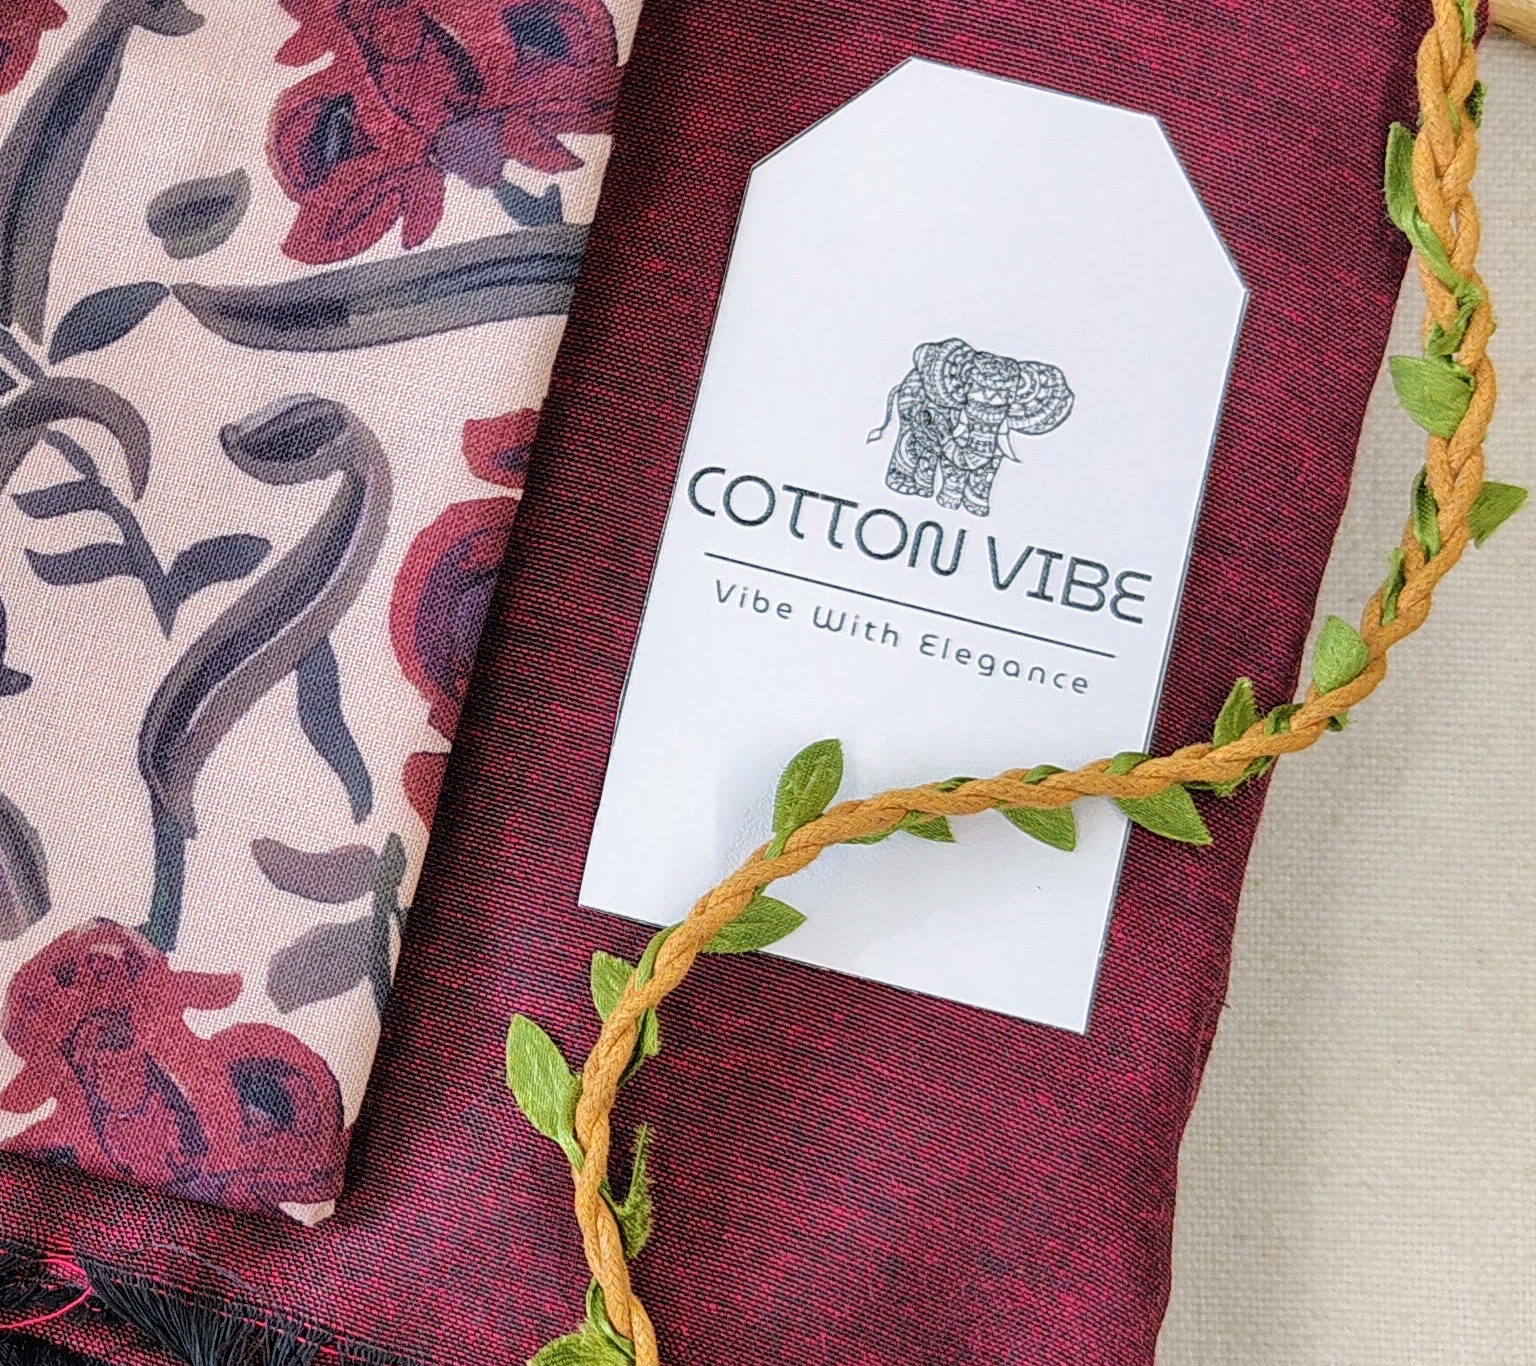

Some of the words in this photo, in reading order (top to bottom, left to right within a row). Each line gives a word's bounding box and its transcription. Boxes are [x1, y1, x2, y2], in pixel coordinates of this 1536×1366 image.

[687, 466, 967, 577] COTTON
[986, 535, 1153, 625] VIBE
[715, 580, 793, 620] Vibe
[813, 606, 900, 647] With
[919, 633, 1089, 694] Elegance
